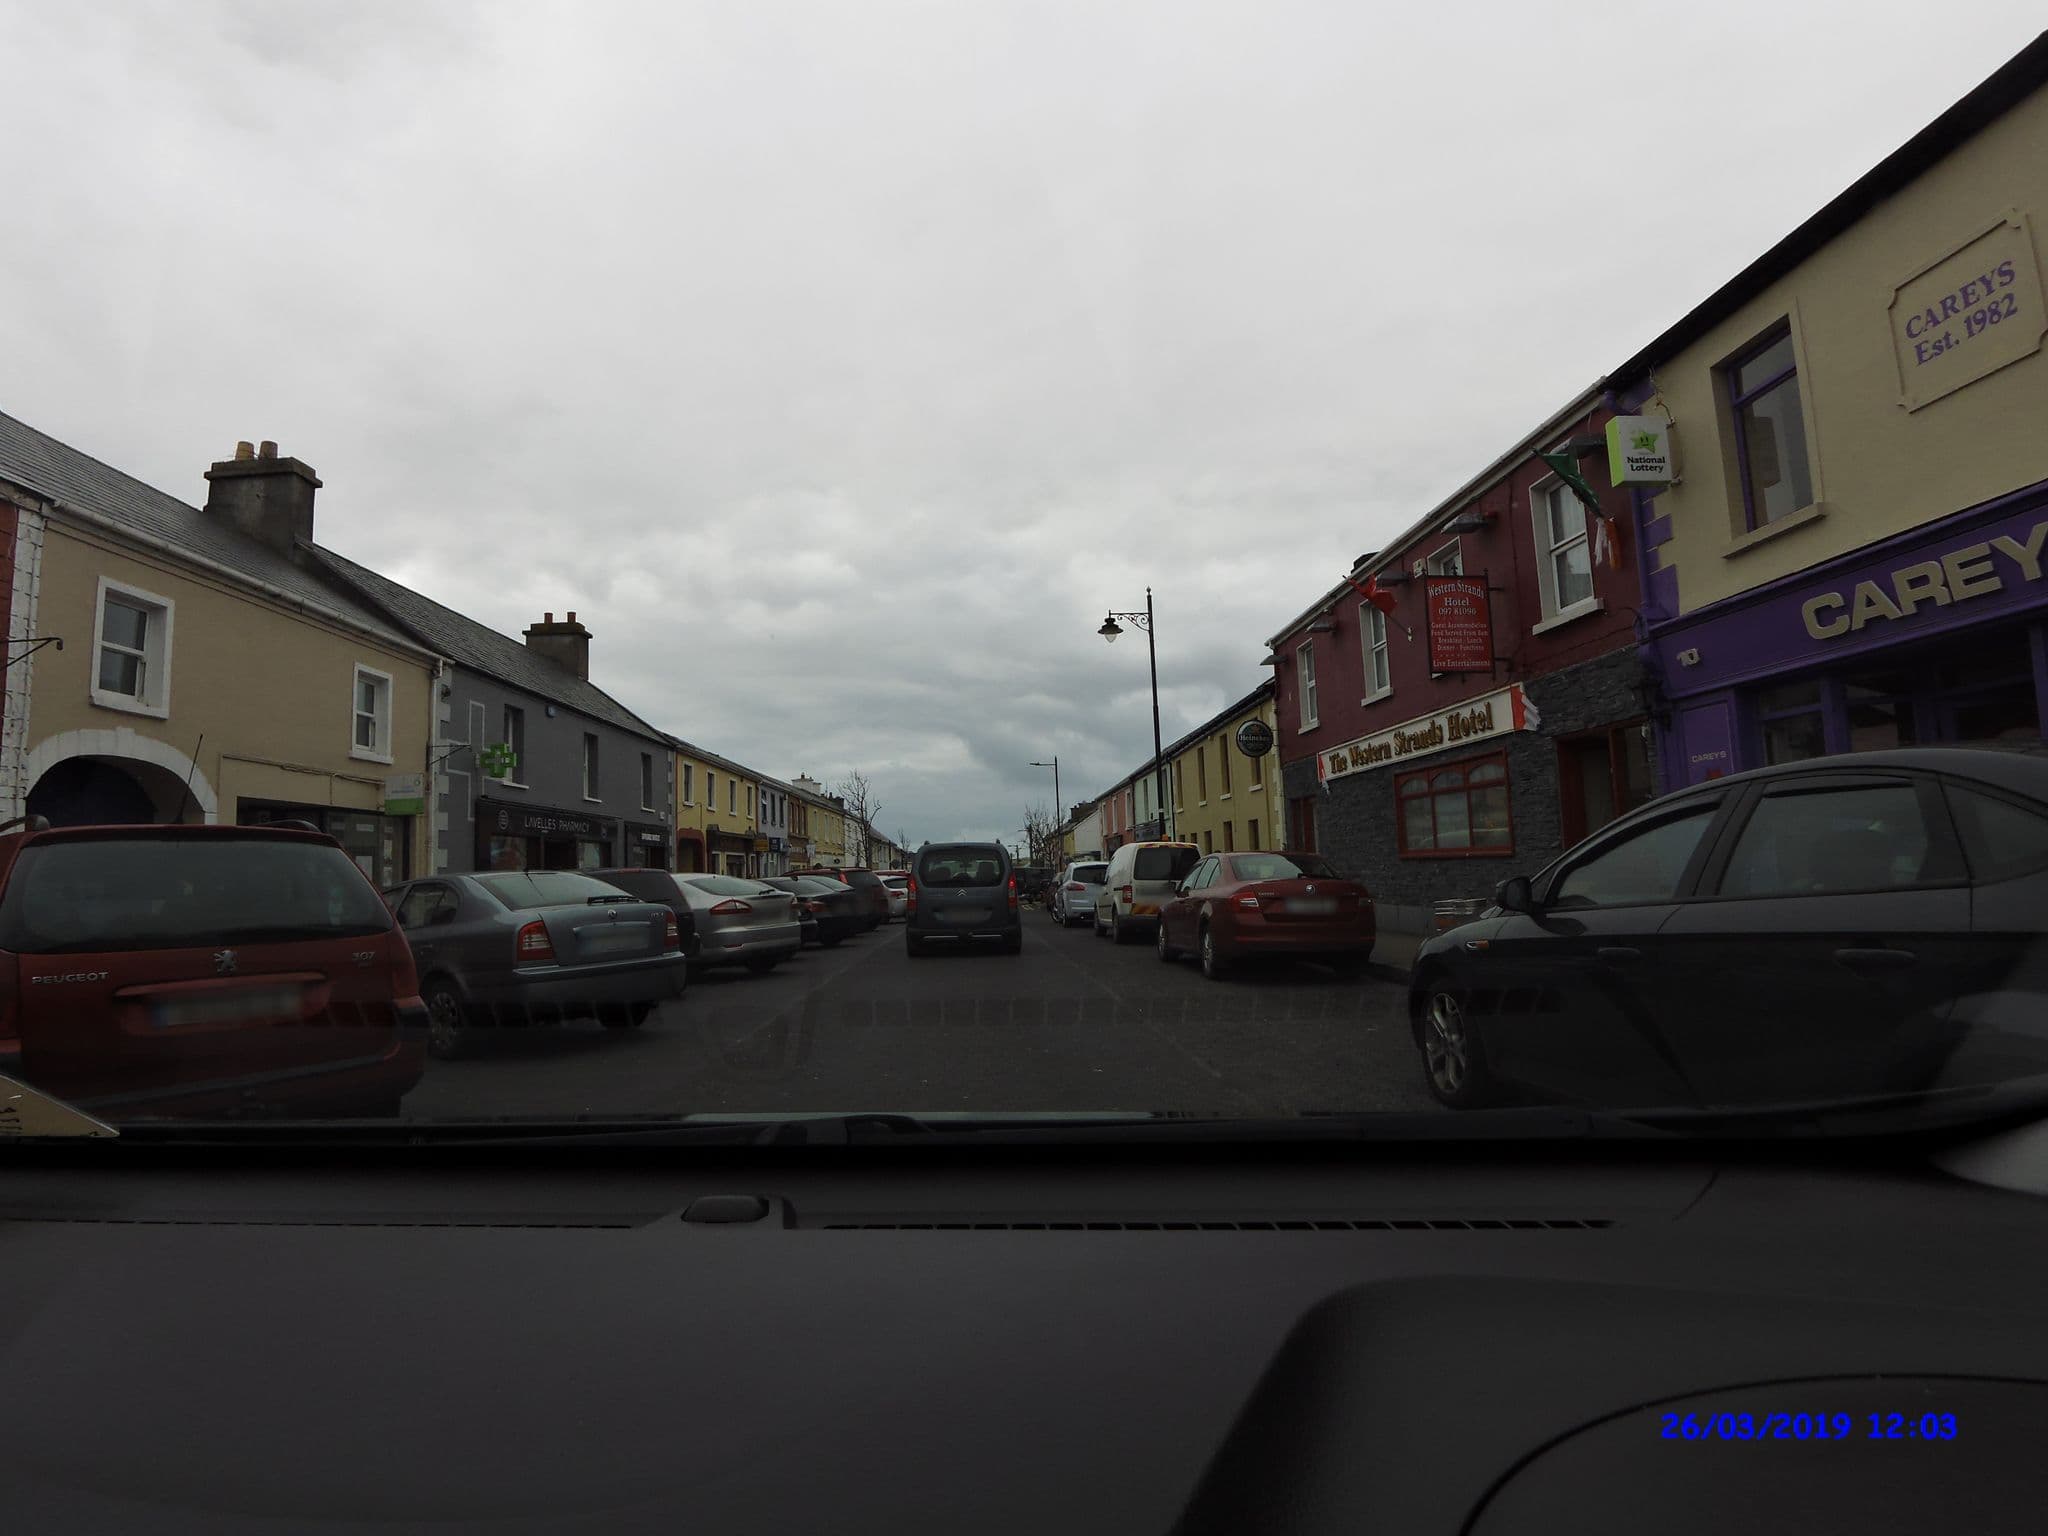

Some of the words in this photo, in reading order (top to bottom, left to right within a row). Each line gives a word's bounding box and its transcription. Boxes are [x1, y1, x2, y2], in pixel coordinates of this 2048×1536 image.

[1905, 260, 2016, 340] CAREYS
[1914, 331, 1961, 366] Est.
[1963, 292, 2019, 339] 1982
[1627, 456, 1666, 464] National
[1631, 464, 1664, 474] Lottery
[1801, 519, 2048, 641] CAREY
[1428, 583, 1457, 598] Western
[1457, 581, 1485, 599] Strands
[1445, 597, 1470, 606] Hotel
[1438, 607, 1452, 615] 097
[1447, 659, 1491, 668] Entertainment
[1329, 752, 1348, 774] The
[1349, 740, 1392, 768] Western
[1393, 719, 1443, 757] Strands
[1445, 701, 1494, 742] Hotel
[524, 815, 557, 831] LAVELLES
[559, 818, 591, 833] PHARMACY
[353, 951, 376, 962] 307
[31, 970, 110, 985] PEUGEOT
